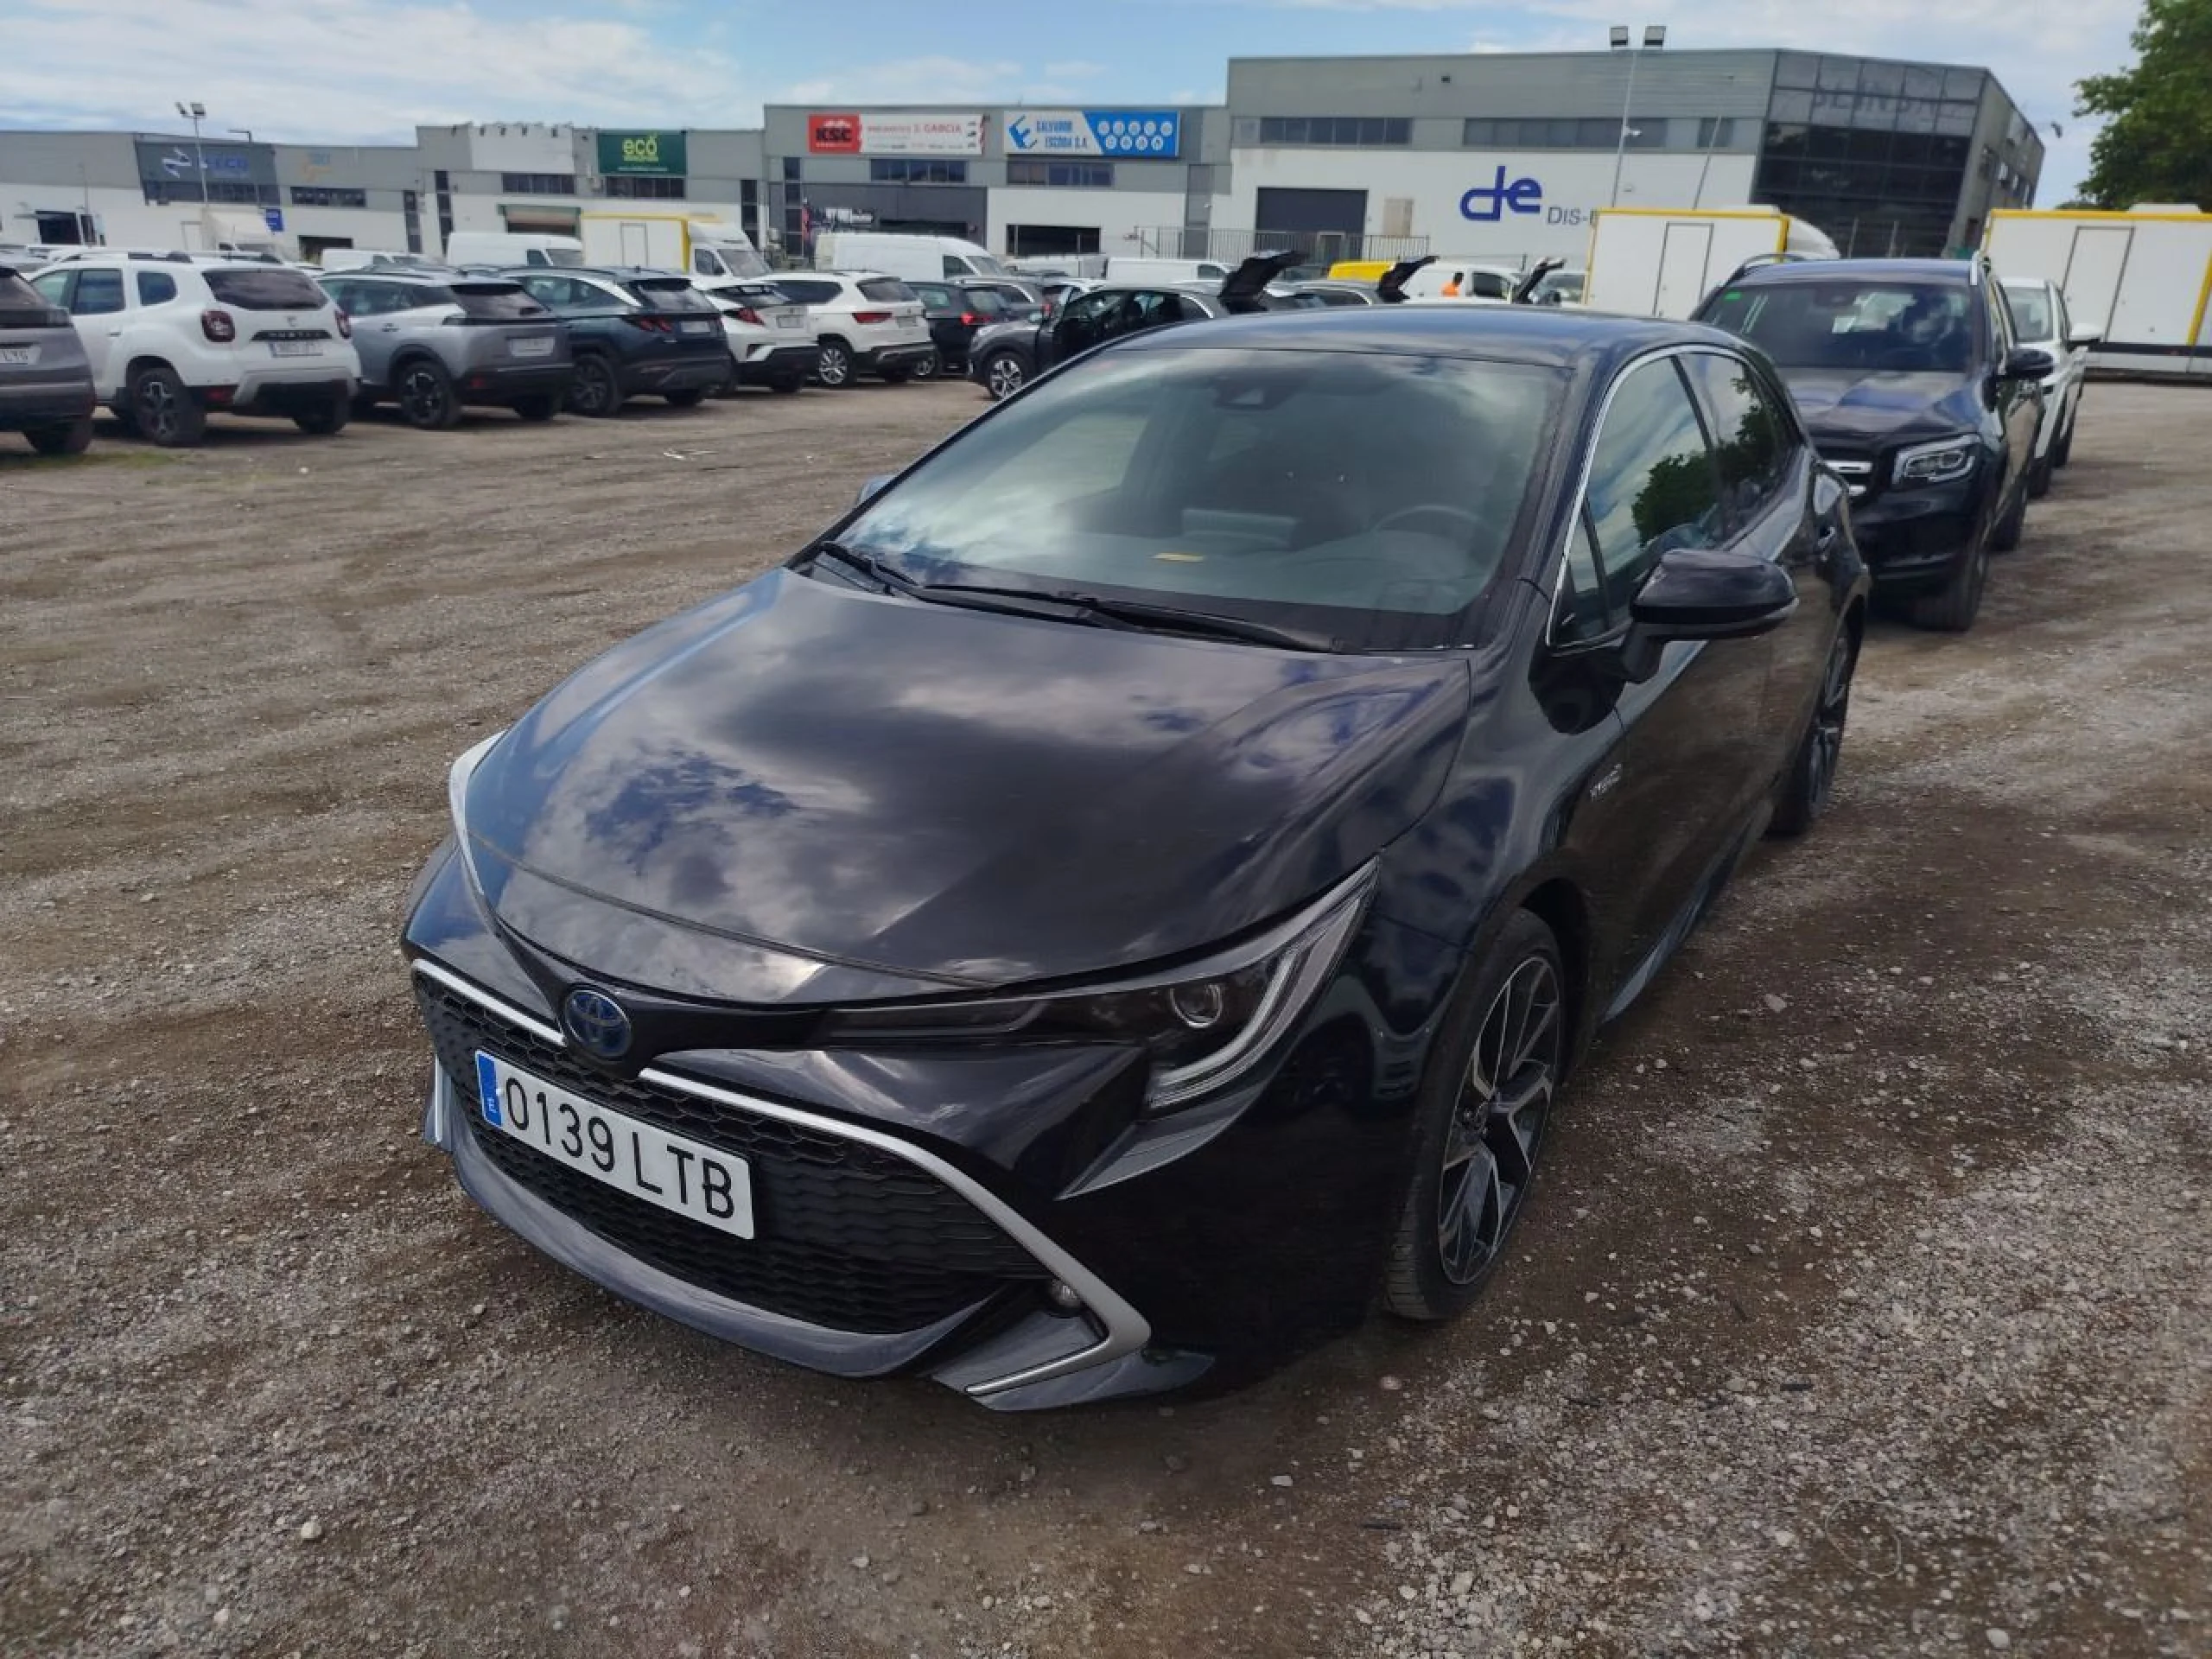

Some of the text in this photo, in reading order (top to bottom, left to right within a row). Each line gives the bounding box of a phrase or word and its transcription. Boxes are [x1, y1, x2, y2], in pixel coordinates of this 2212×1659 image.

[816, 126, 853, 143] KSC
[1459, 165, 1541, 222] de
[486, 1096, 497, 1114] E
[505, 1077, 735, 1219] 0139 LTB
